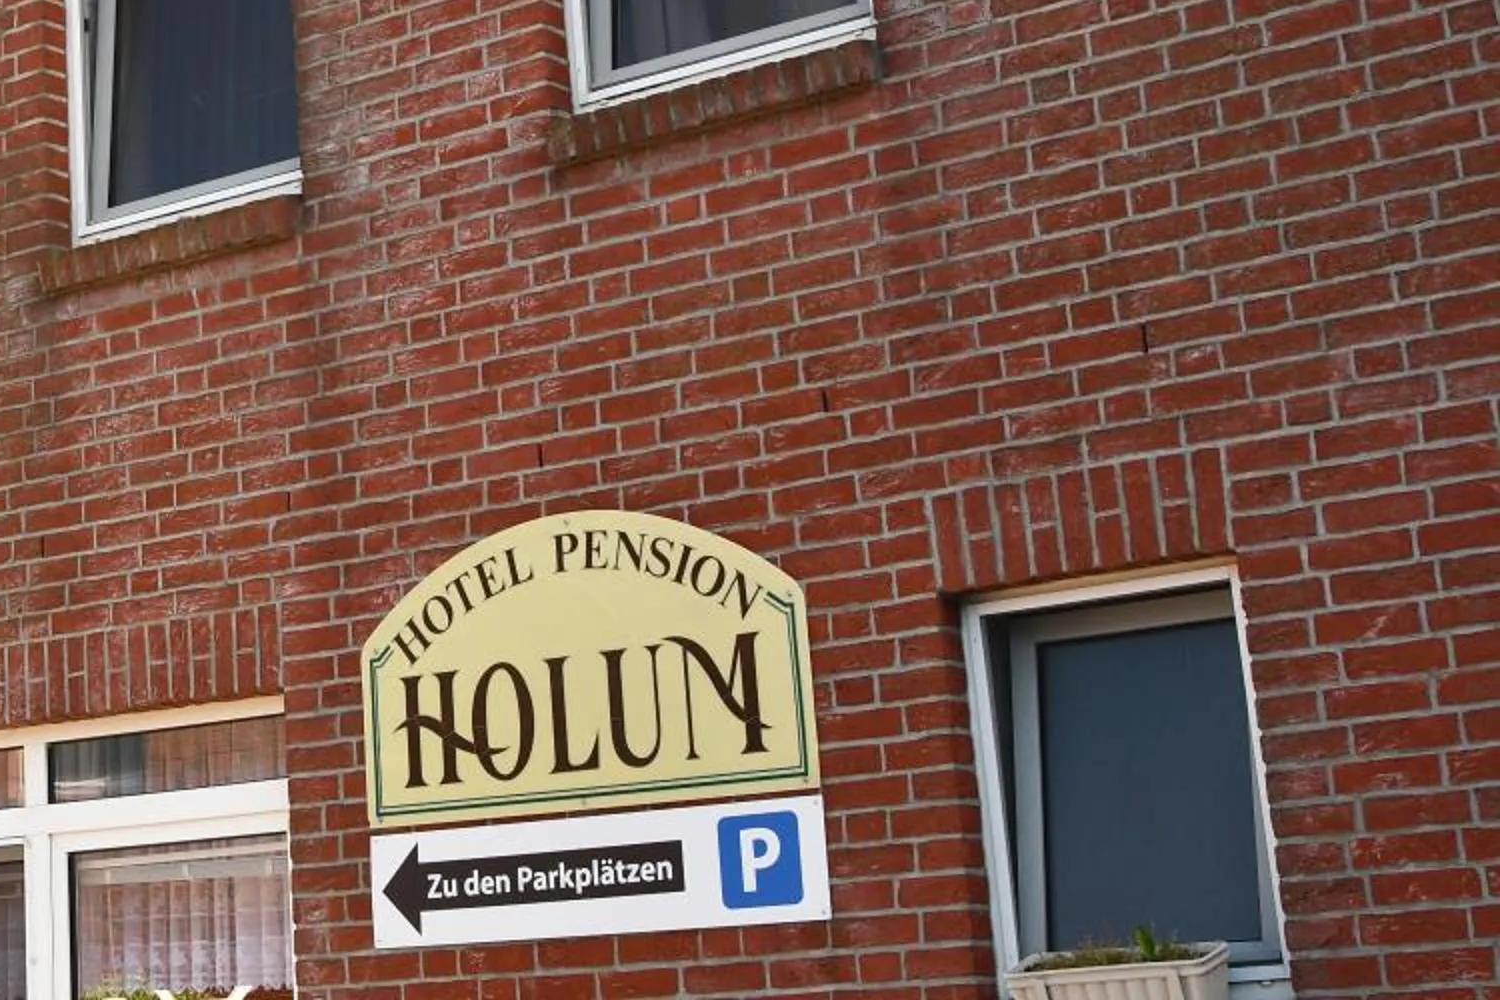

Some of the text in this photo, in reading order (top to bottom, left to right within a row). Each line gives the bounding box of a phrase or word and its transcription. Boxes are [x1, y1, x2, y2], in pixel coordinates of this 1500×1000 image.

[393, 529, 763, 666] HOTEL PENSION
[394, 631, 773, 789] HOLUM
[427, 859, 674, 899] Zu den Parkplätzen
[739, 827, 782, 893] P
